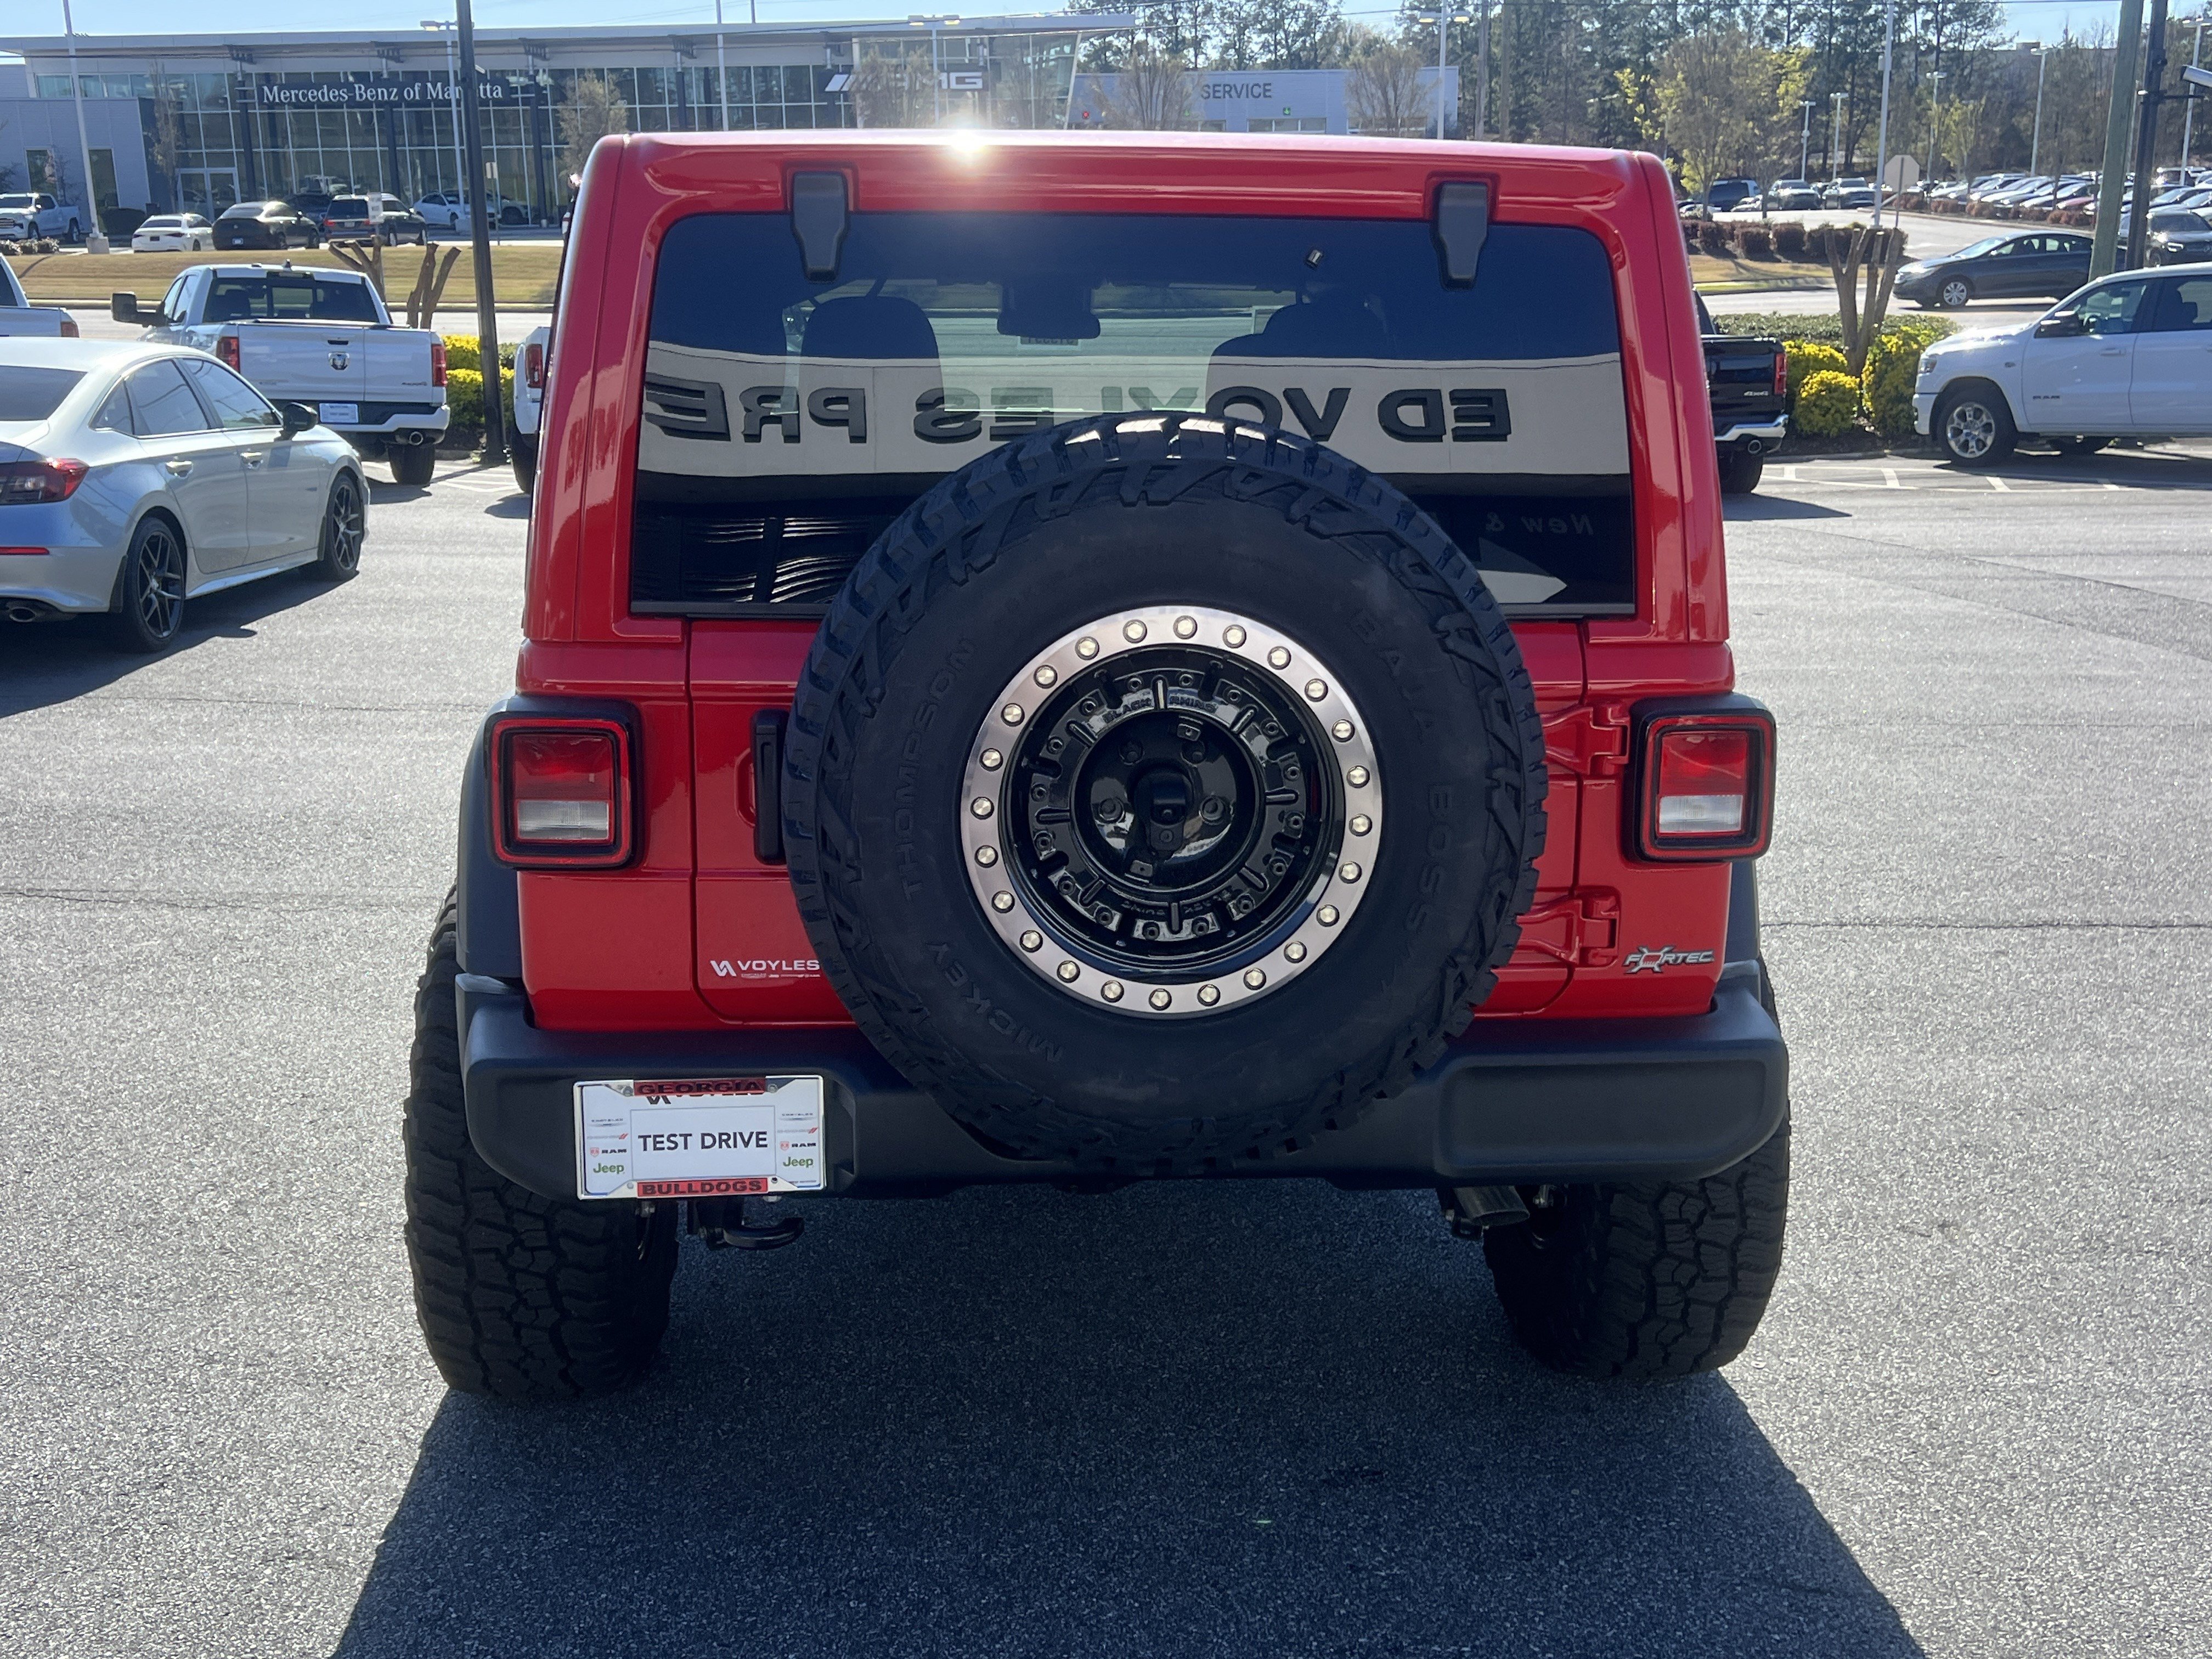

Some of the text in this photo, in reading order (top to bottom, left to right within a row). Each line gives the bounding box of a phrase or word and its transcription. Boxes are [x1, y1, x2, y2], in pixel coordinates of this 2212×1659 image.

[262, 82, 503, 103] Mercedes-Benz of Martta
[1200, 82, 1272, 99] SERVICE
[894, 637, 976, 904] THOMPSON
[737, 960, 820, 970] VOYLES
[638, 1081, 761, 1094] GEORGIA
[638, 1131, 768, 1152] TEST DRIVE
[593, 1163, 624, 1174] Jeep
[783, 1156, 814, 1168] Jeep
[642, 1181, 762, 1195] BULLDOGS
